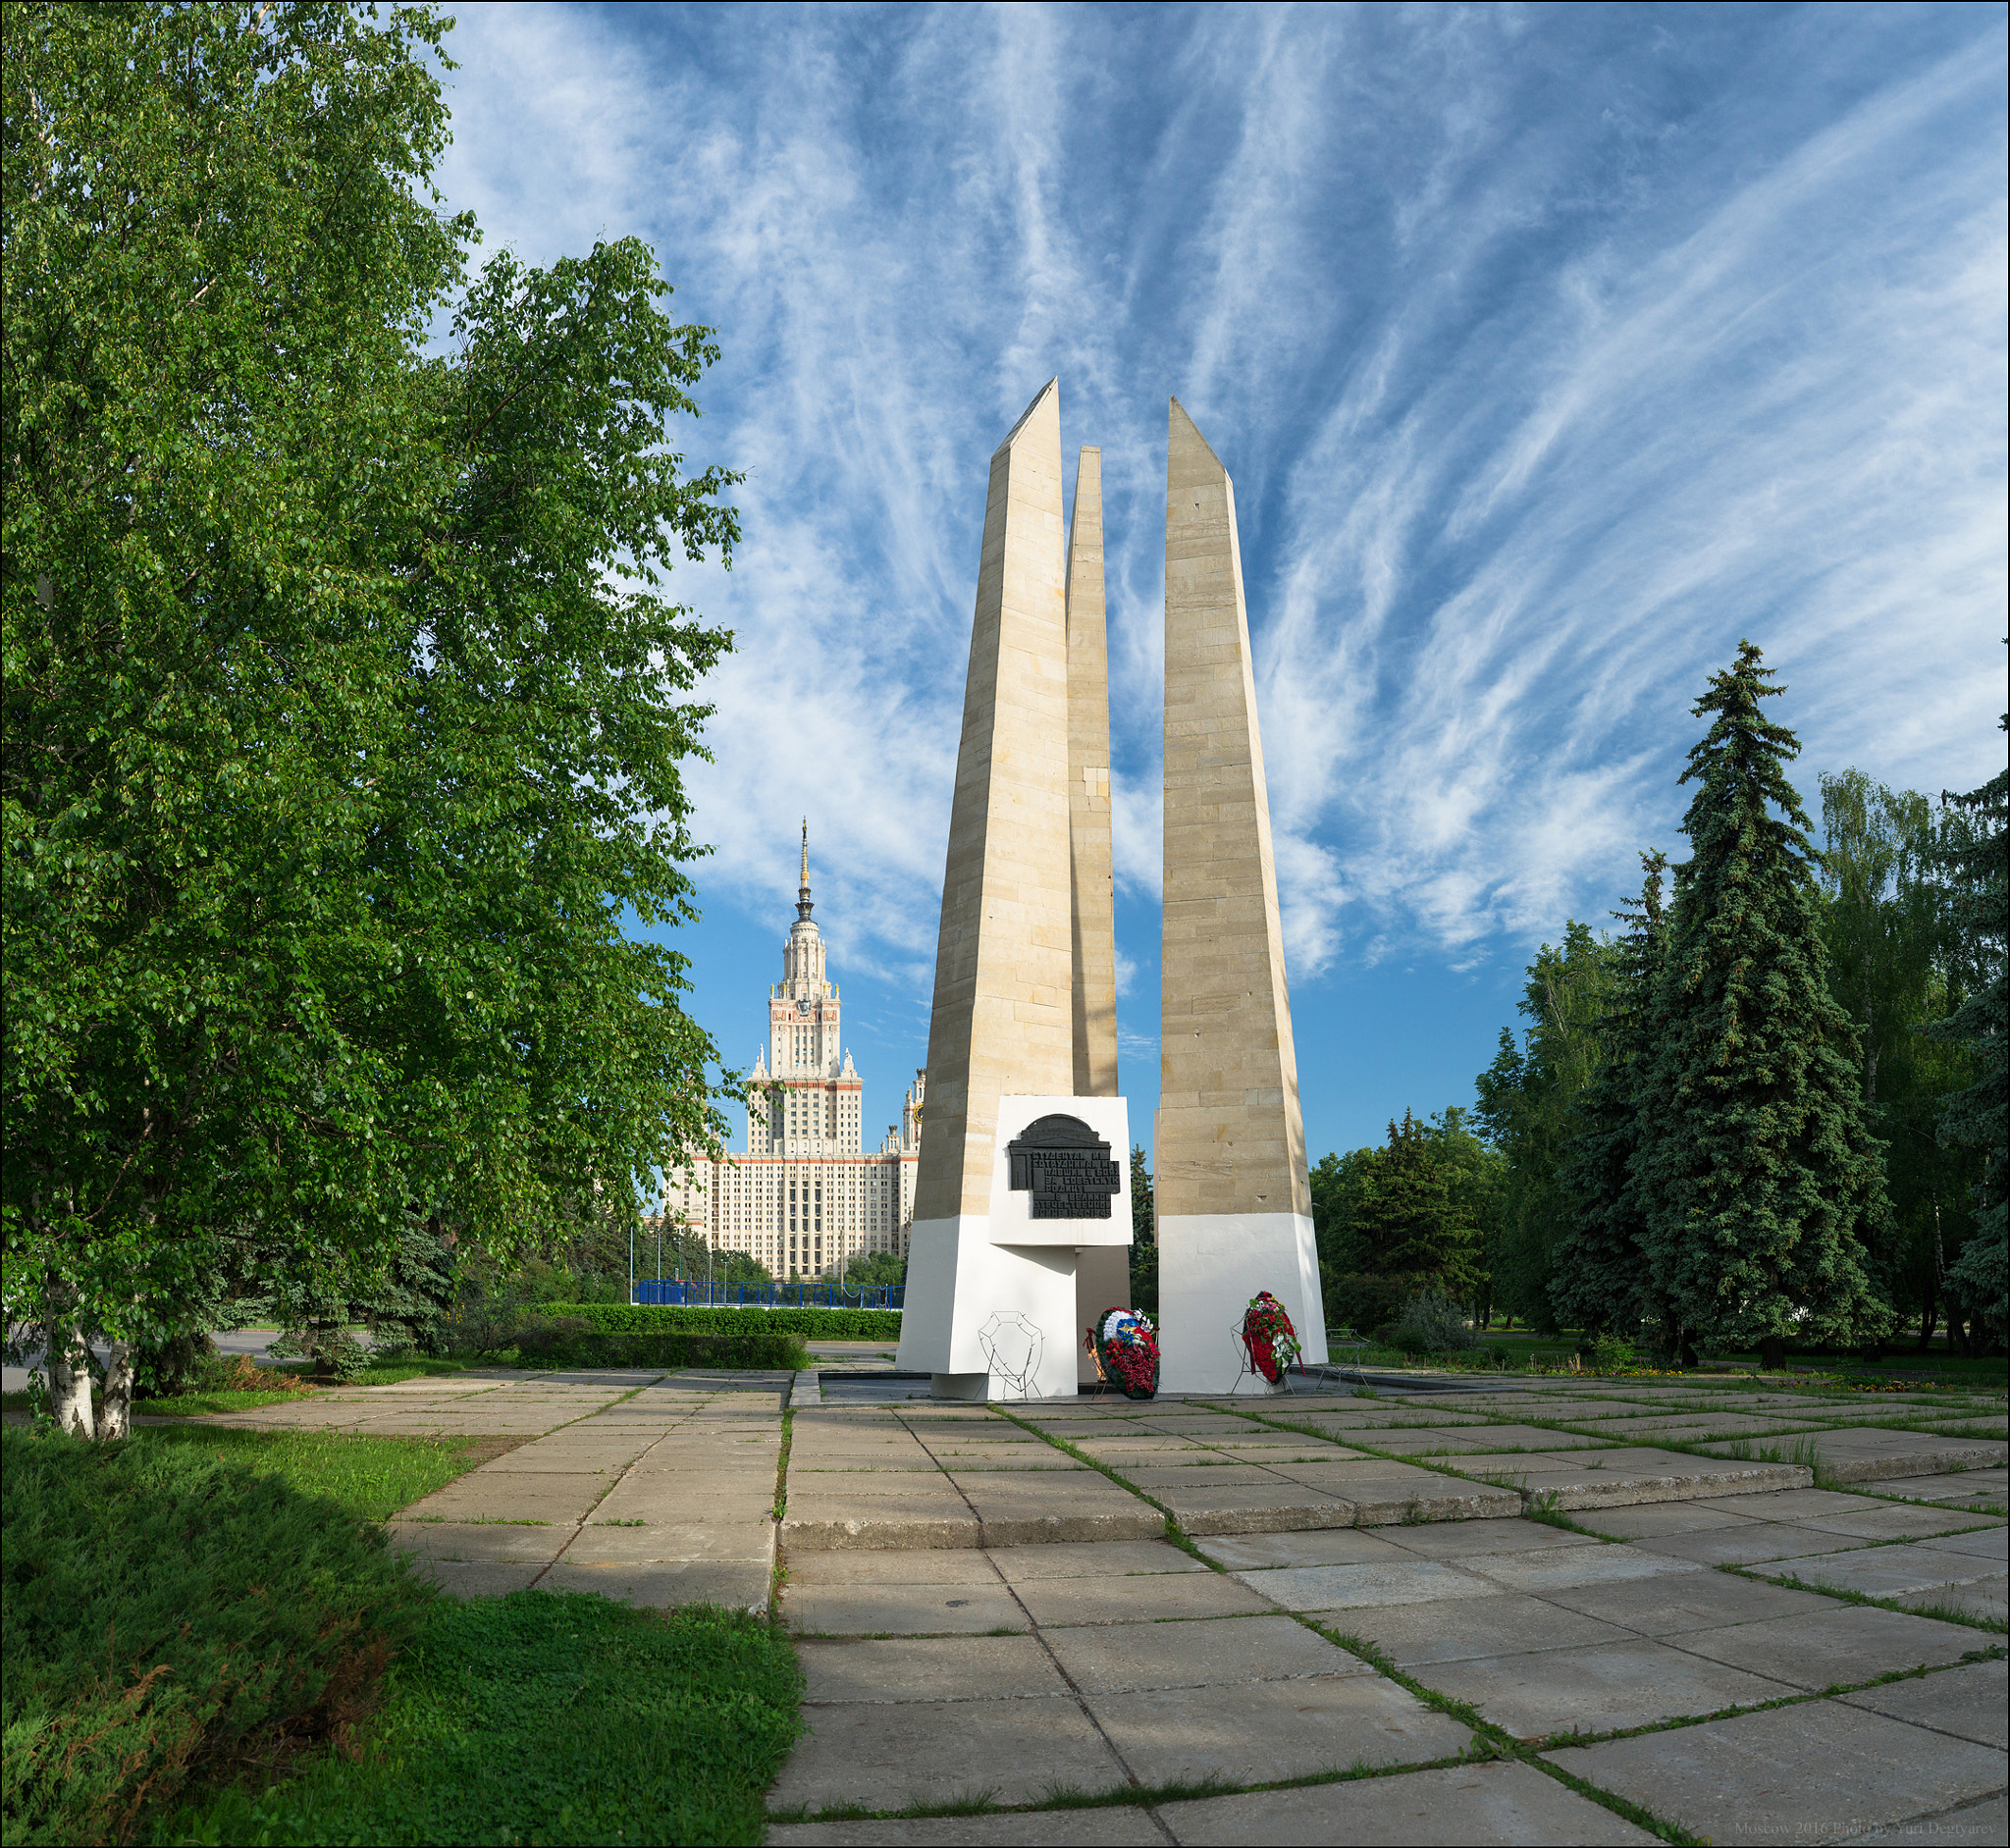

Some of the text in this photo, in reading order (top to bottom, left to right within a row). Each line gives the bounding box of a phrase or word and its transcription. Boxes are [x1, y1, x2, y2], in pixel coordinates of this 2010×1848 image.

[1085, 1168, 1093, 1177] В
[1044, 1176, 1058, 1185] ЗА
[1054, 1192, 1062, 1201] В
